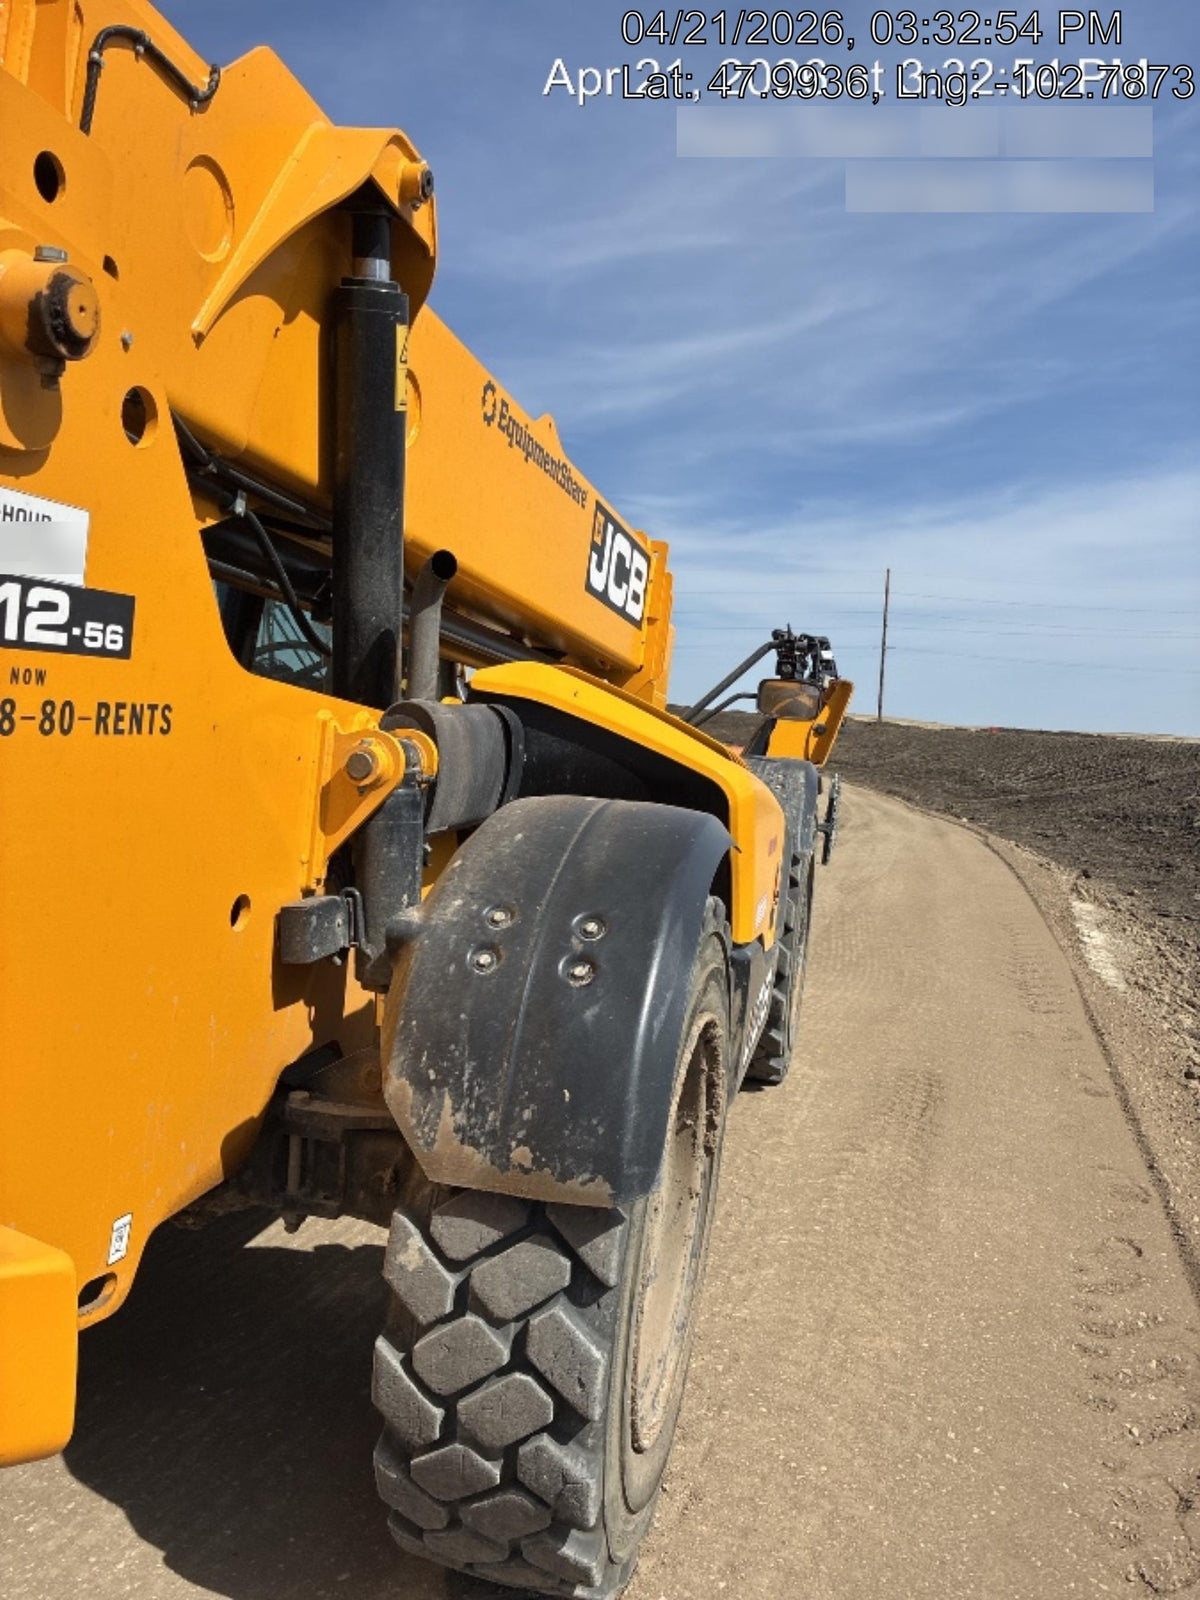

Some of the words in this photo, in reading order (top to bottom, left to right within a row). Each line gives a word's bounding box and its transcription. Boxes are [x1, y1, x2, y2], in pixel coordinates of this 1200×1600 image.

[497, 397, 588, 510] EquipmentShare
[589, 521, 648, 621] JCB
[10, 667, 47, 686] NOW
